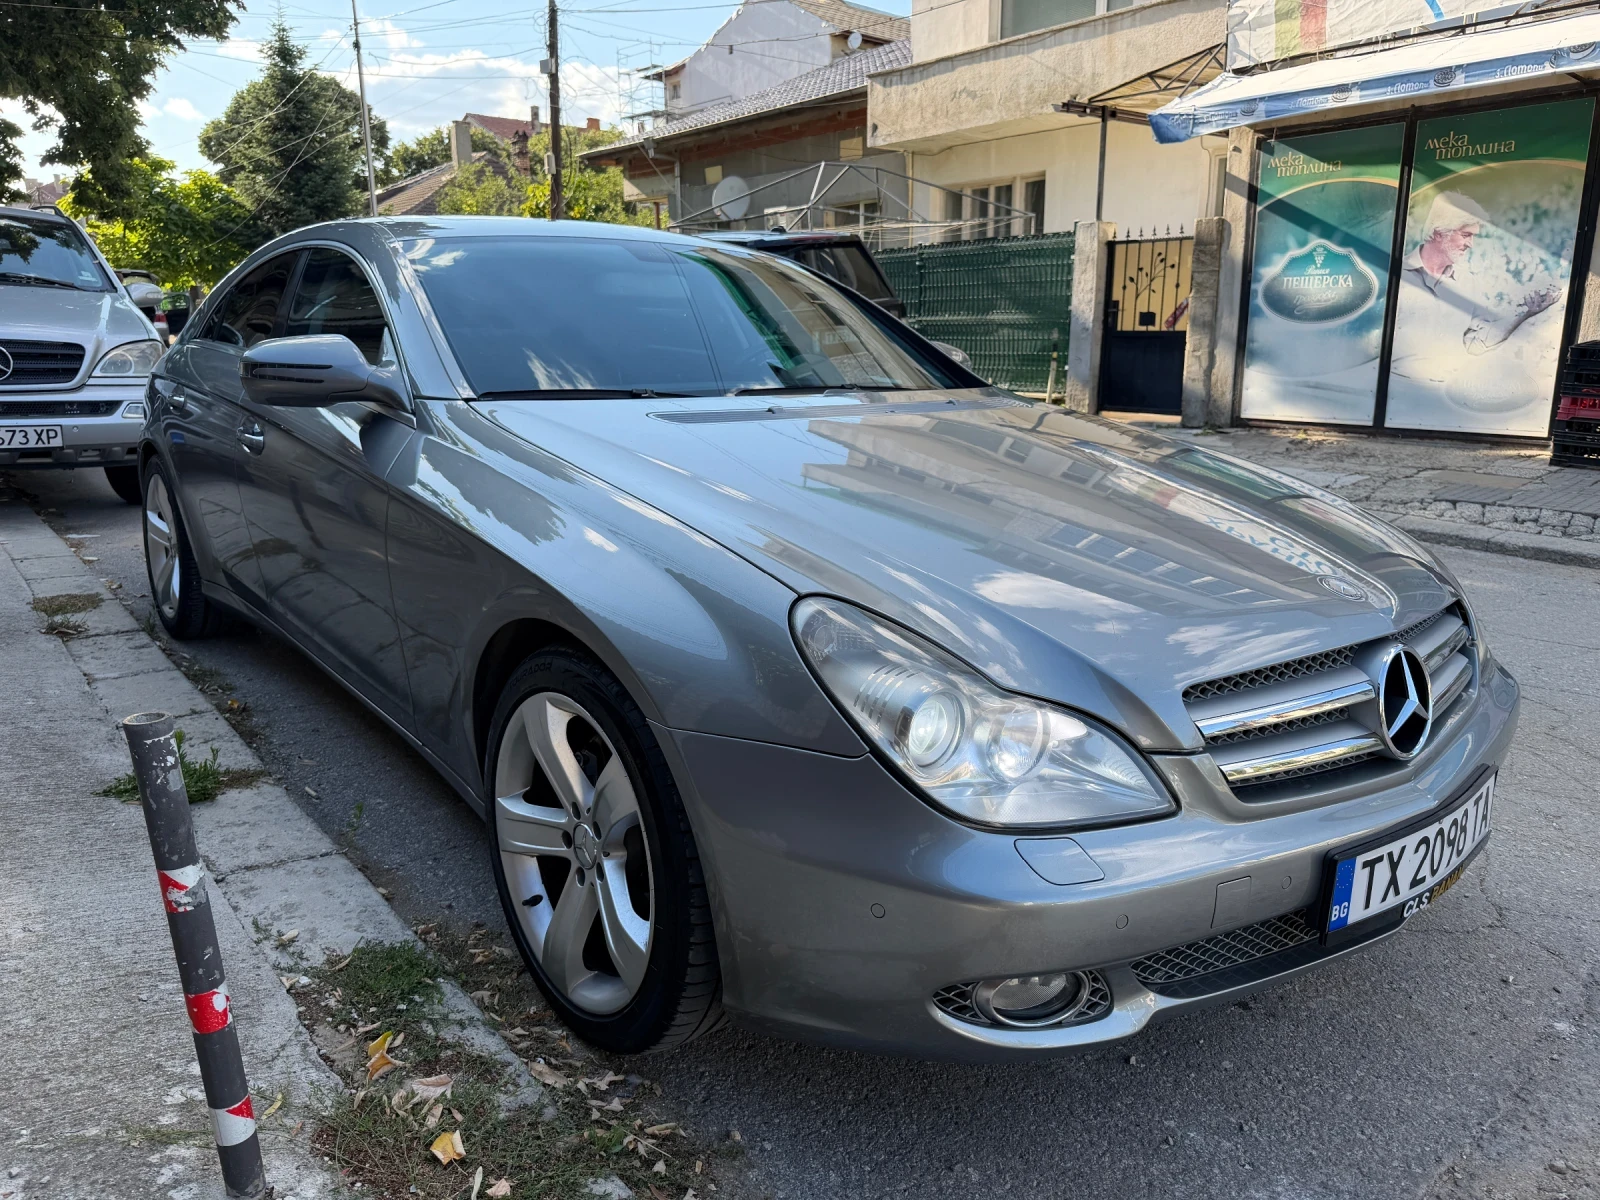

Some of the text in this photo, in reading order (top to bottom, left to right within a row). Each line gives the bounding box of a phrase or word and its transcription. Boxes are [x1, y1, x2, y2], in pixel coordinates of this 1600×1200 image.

[1283, 274, 1353, 290] ПЕЩЕРСКА
[1362, 786, 1491, 910] TX 2098 TA
[1331, 902, 1349, 921] BG
[1403, 892, 1430, 918] CLS
